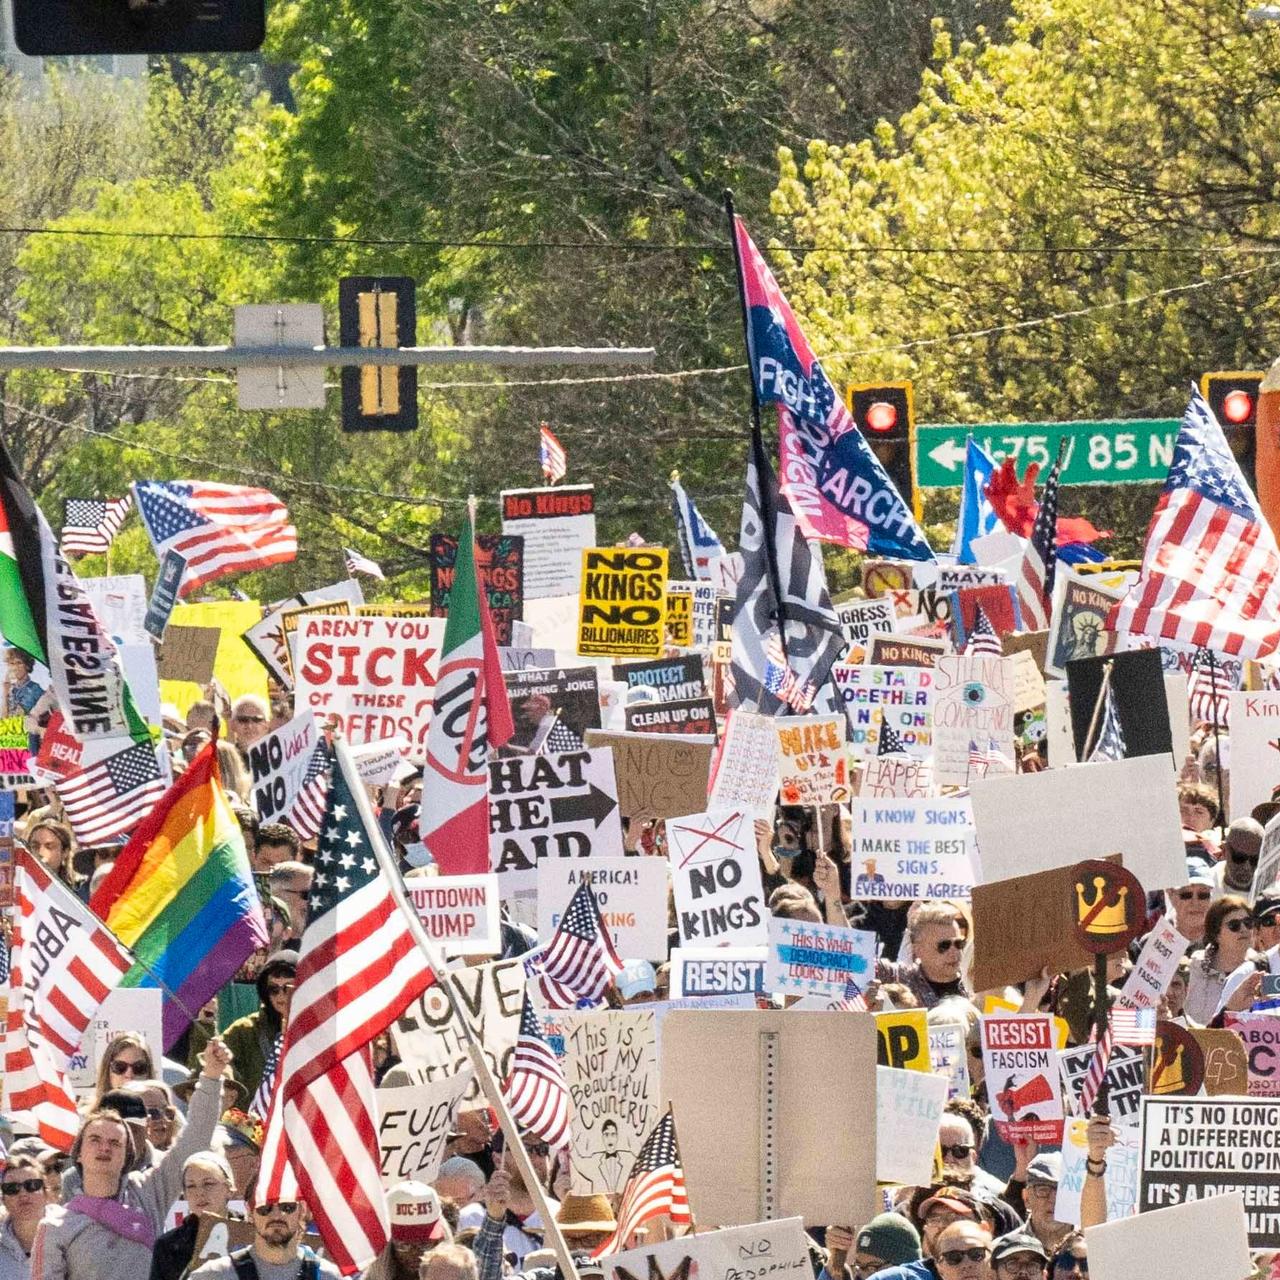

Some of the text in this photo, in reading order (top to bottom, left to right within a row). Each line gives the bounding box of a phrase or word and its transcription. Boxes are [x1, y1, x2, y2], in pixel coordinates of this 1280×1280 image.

[1090, 434, 1137, 469] 85
[586, 551, 663, 571] NO
[585, 574, 663, 600] KINGS
[583, 606, 660, 625] NO
[306, 619, 429, 639] AREN'T YOU
[581, 626, 660, 646] BILLIONAIRES
[302, 647, 437, 686] SICK
[862, 839, 966, 855] MAKE THE BEST
[689, 859, 742, 898] NO
[855, 881, 971, 897] EVERYONE AGREES
[682, 897, 760, 940] KINGS
[989, 1022, 1047, 1045] RESIST
[991, 1051, 1049, 1069] FASCISM
[1165, 1106, 1194, 1125] IT'S
[1201, 1107, 1225, 1125] NO
[1160, 1129, 1171, 1146] A
[1150, 1151, 1235, 1169] POLITICAL
